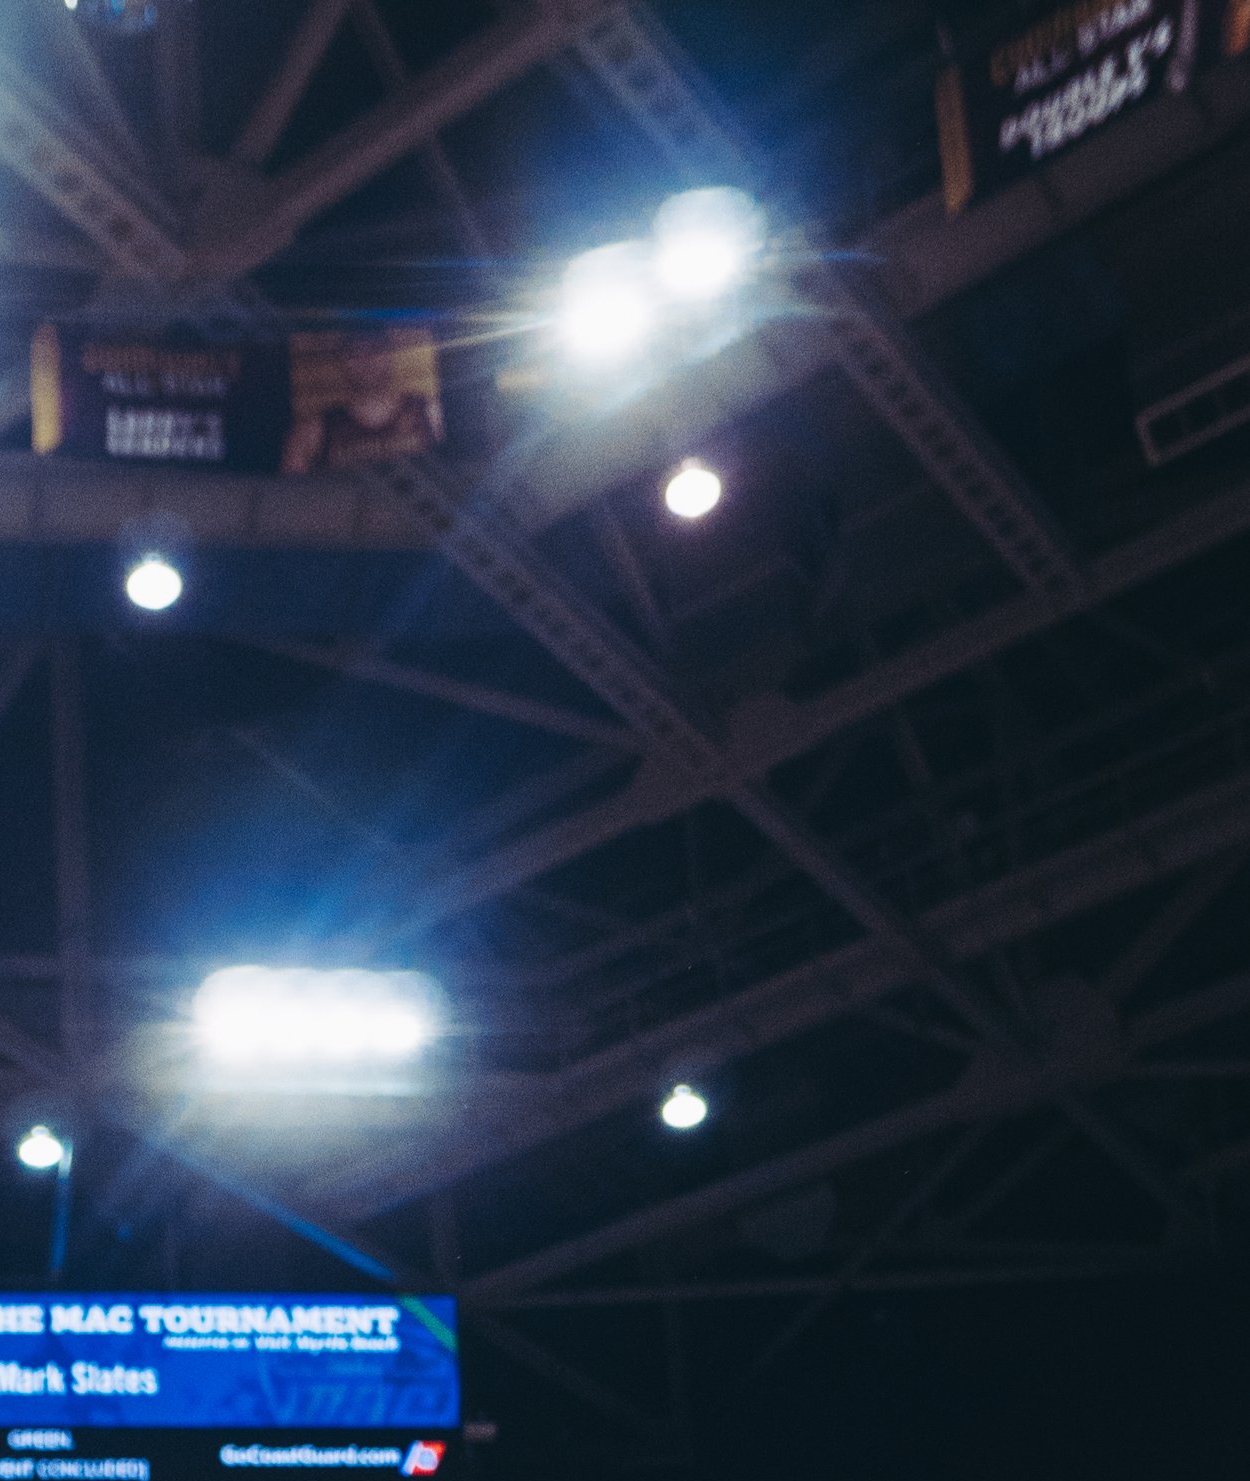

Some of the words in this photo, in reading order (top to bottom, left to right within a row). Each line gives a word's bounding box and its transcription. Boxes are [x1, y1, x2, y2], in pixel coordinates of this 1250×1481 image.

[50, 1305, 134, 1334] MAC
[139, 1305, 398, 1335] TOURNAMENT
[220, 1444, 401, 1467] GoCoastGuard.com
